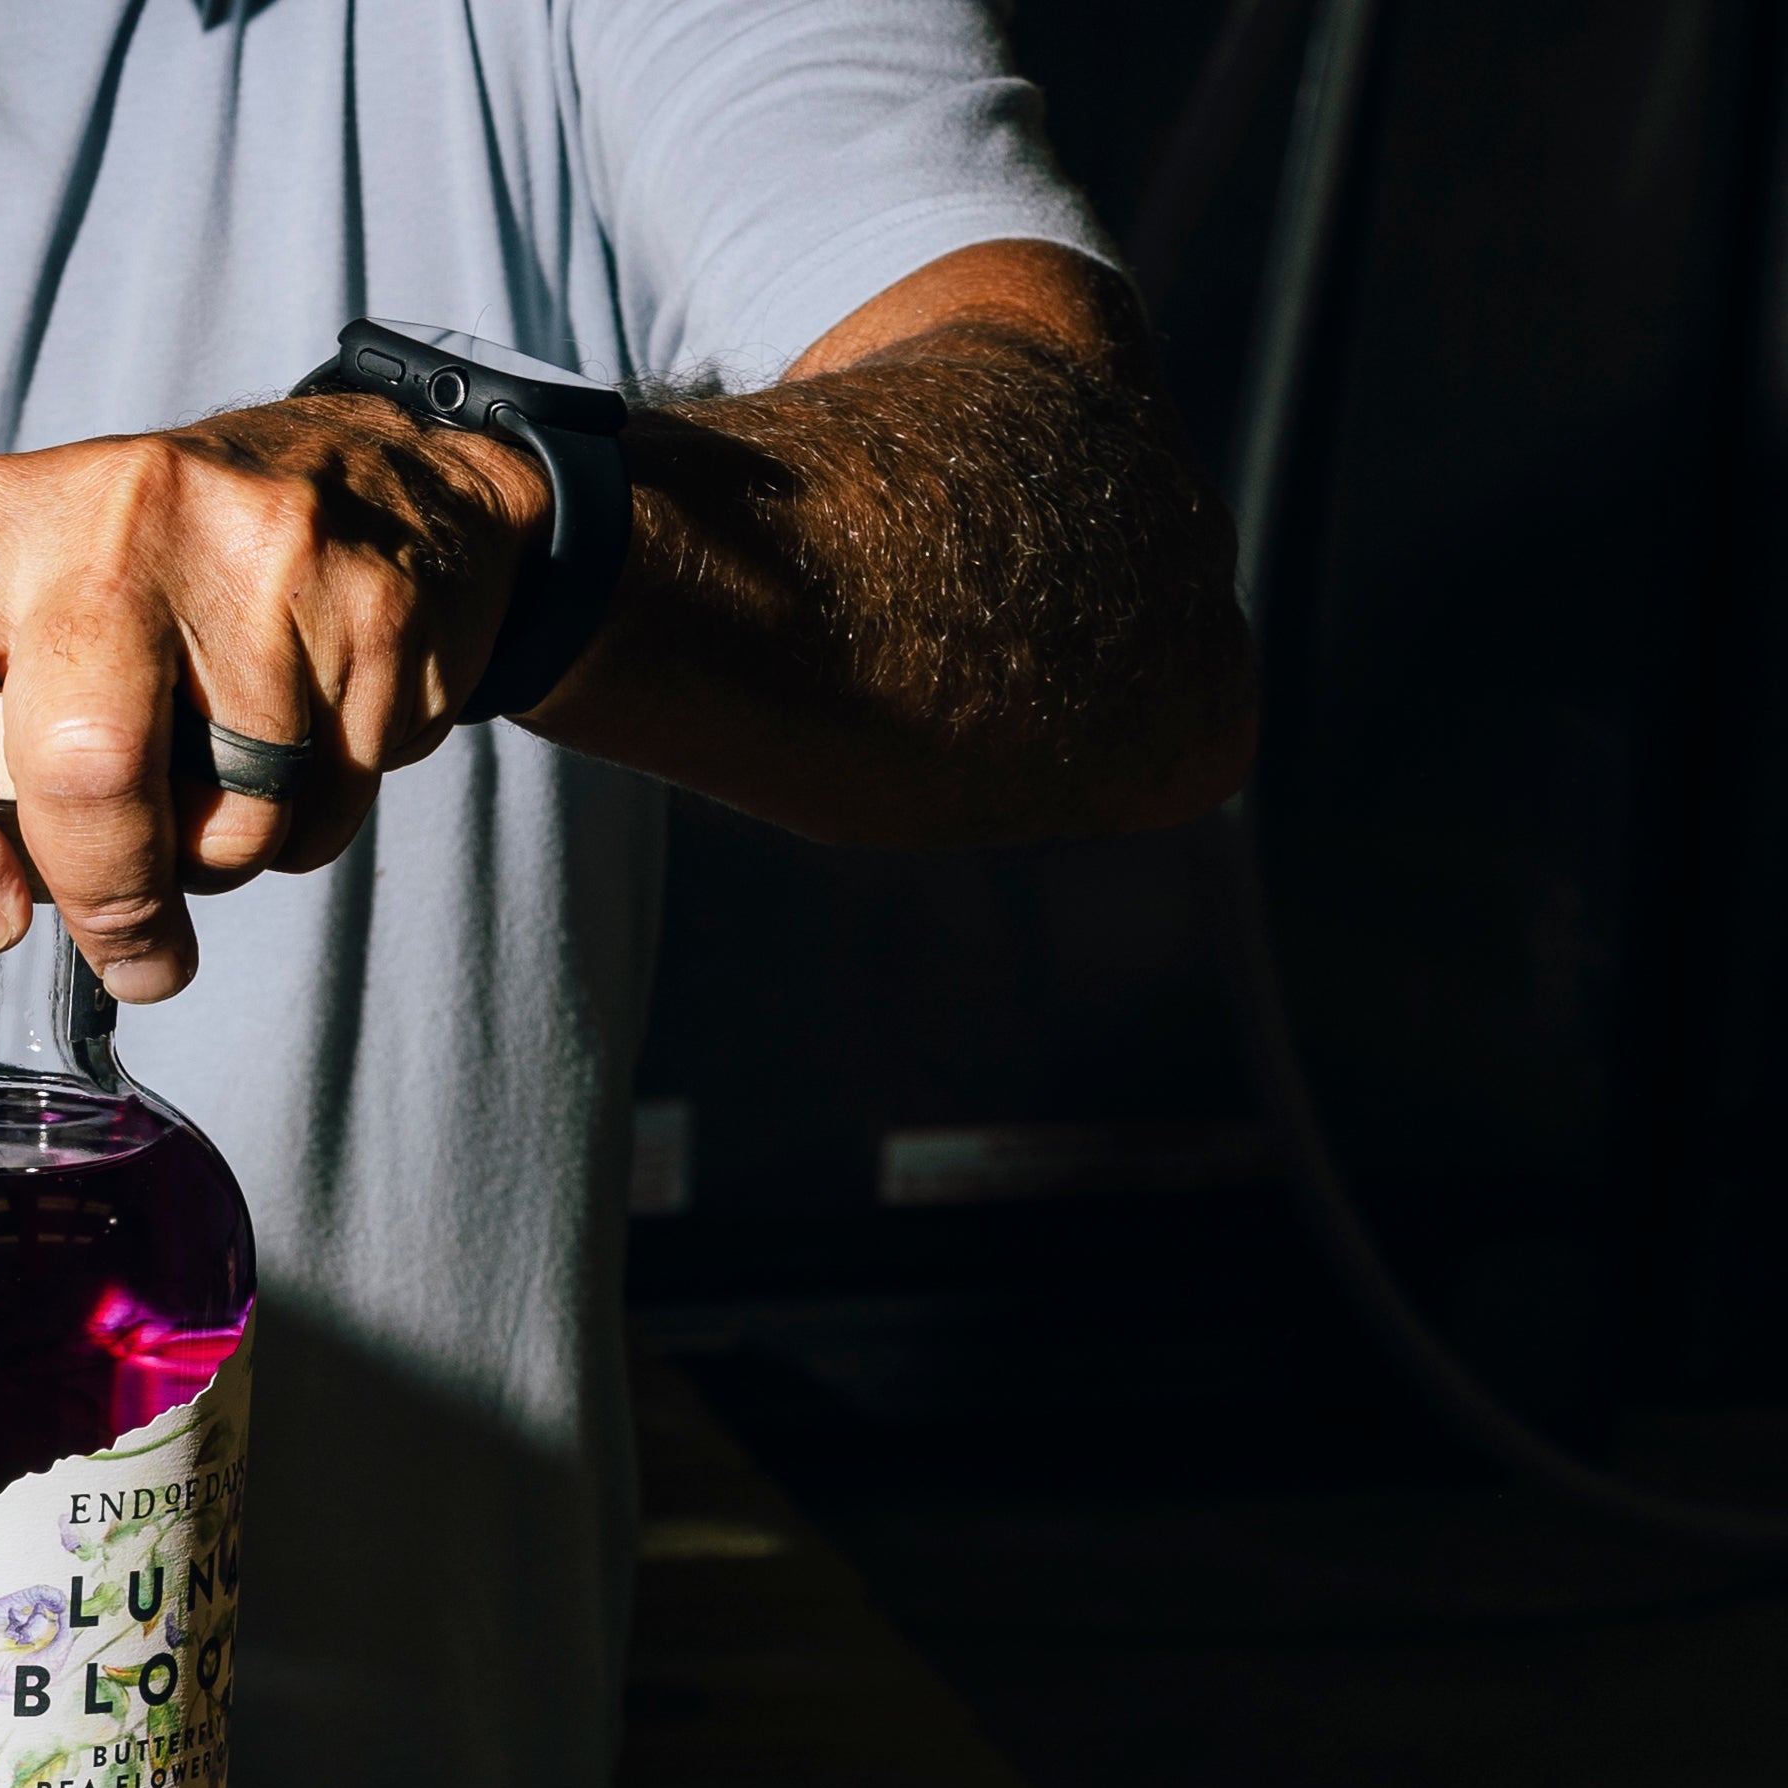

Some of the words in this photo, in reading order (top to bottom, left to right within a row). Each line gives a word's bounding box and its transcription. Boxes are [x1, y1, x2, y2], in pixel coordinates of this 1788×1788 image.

[69, 1487, 156, 1524] END
[164, 1478, 200, 1513] OF
[69, 1540, 238, 1628] LUNA
[13, 1636, 233, 1717] BLOO
